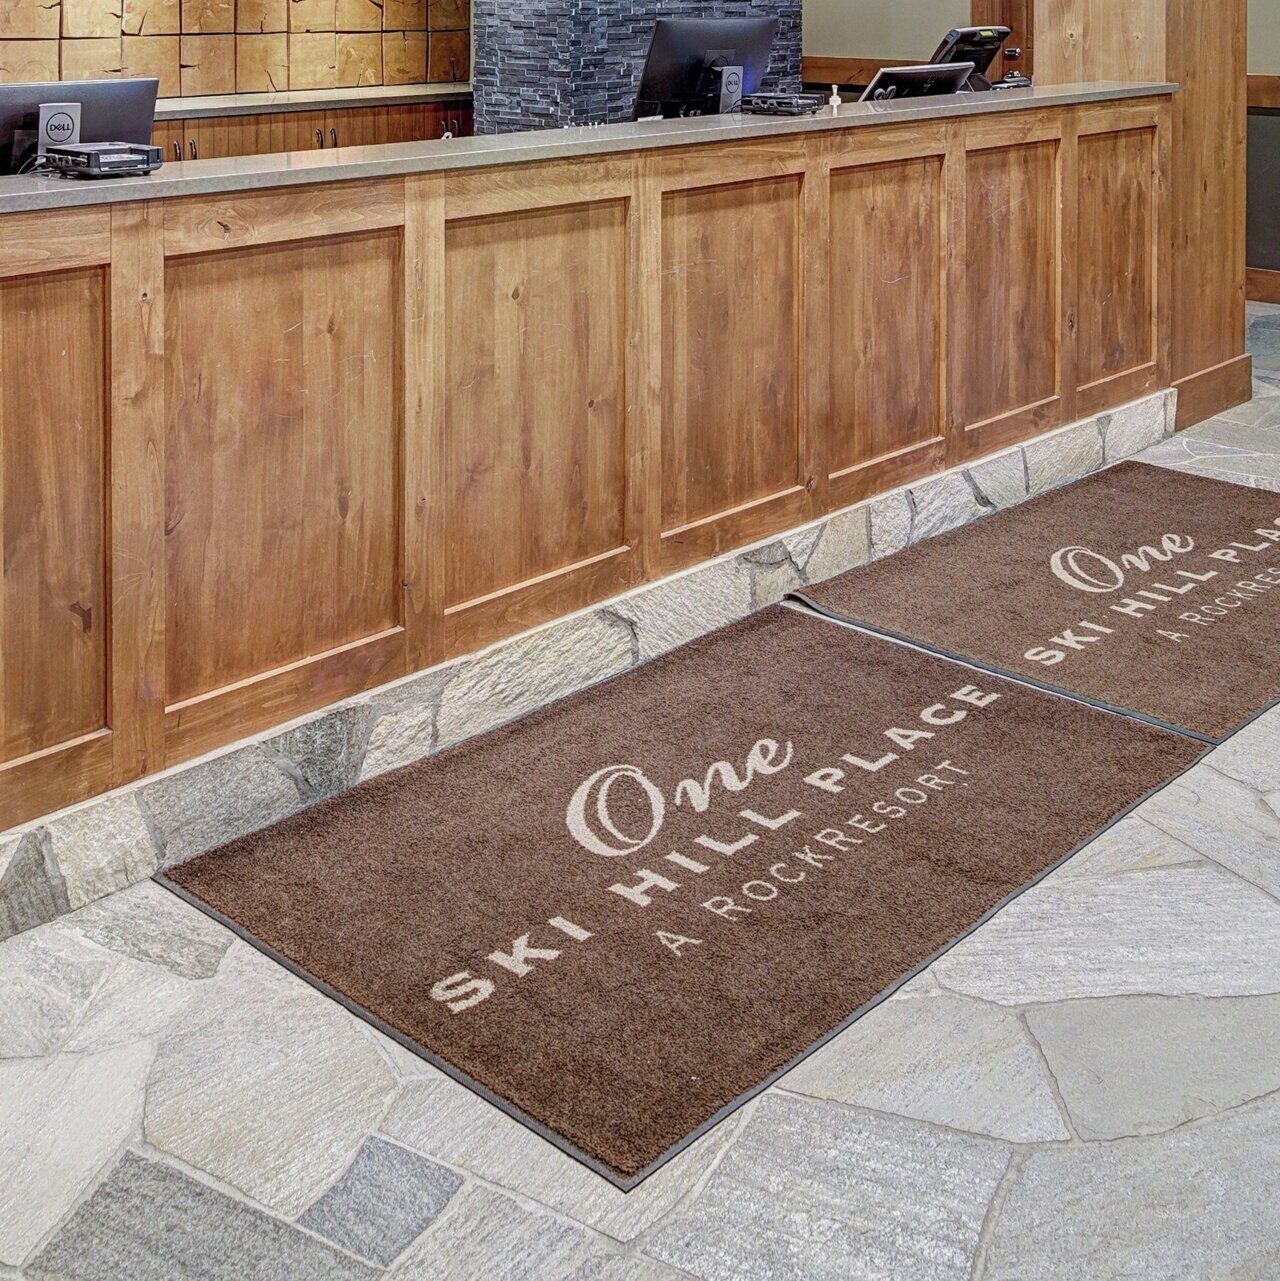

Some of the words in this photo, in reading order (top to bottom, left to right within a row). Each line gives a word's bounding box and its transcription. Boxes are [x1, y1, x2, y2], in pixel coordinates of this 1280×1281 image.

[1050, 533, 1195, 593] One
[1024, 620, 1115, 667] SKI
[1110, 570, 1219, 618] HILL
[1156, 629, 1190, 643] A
[429, 916, 596, 1015] SKI
[608, 807, 802, 907] HILL
[803, 684, 1003, 794] PLACE
[566, 737, 793, 857] One
[656, 926, 704, 957] A
[702, 759, 970, 921] ROCKRESORT
